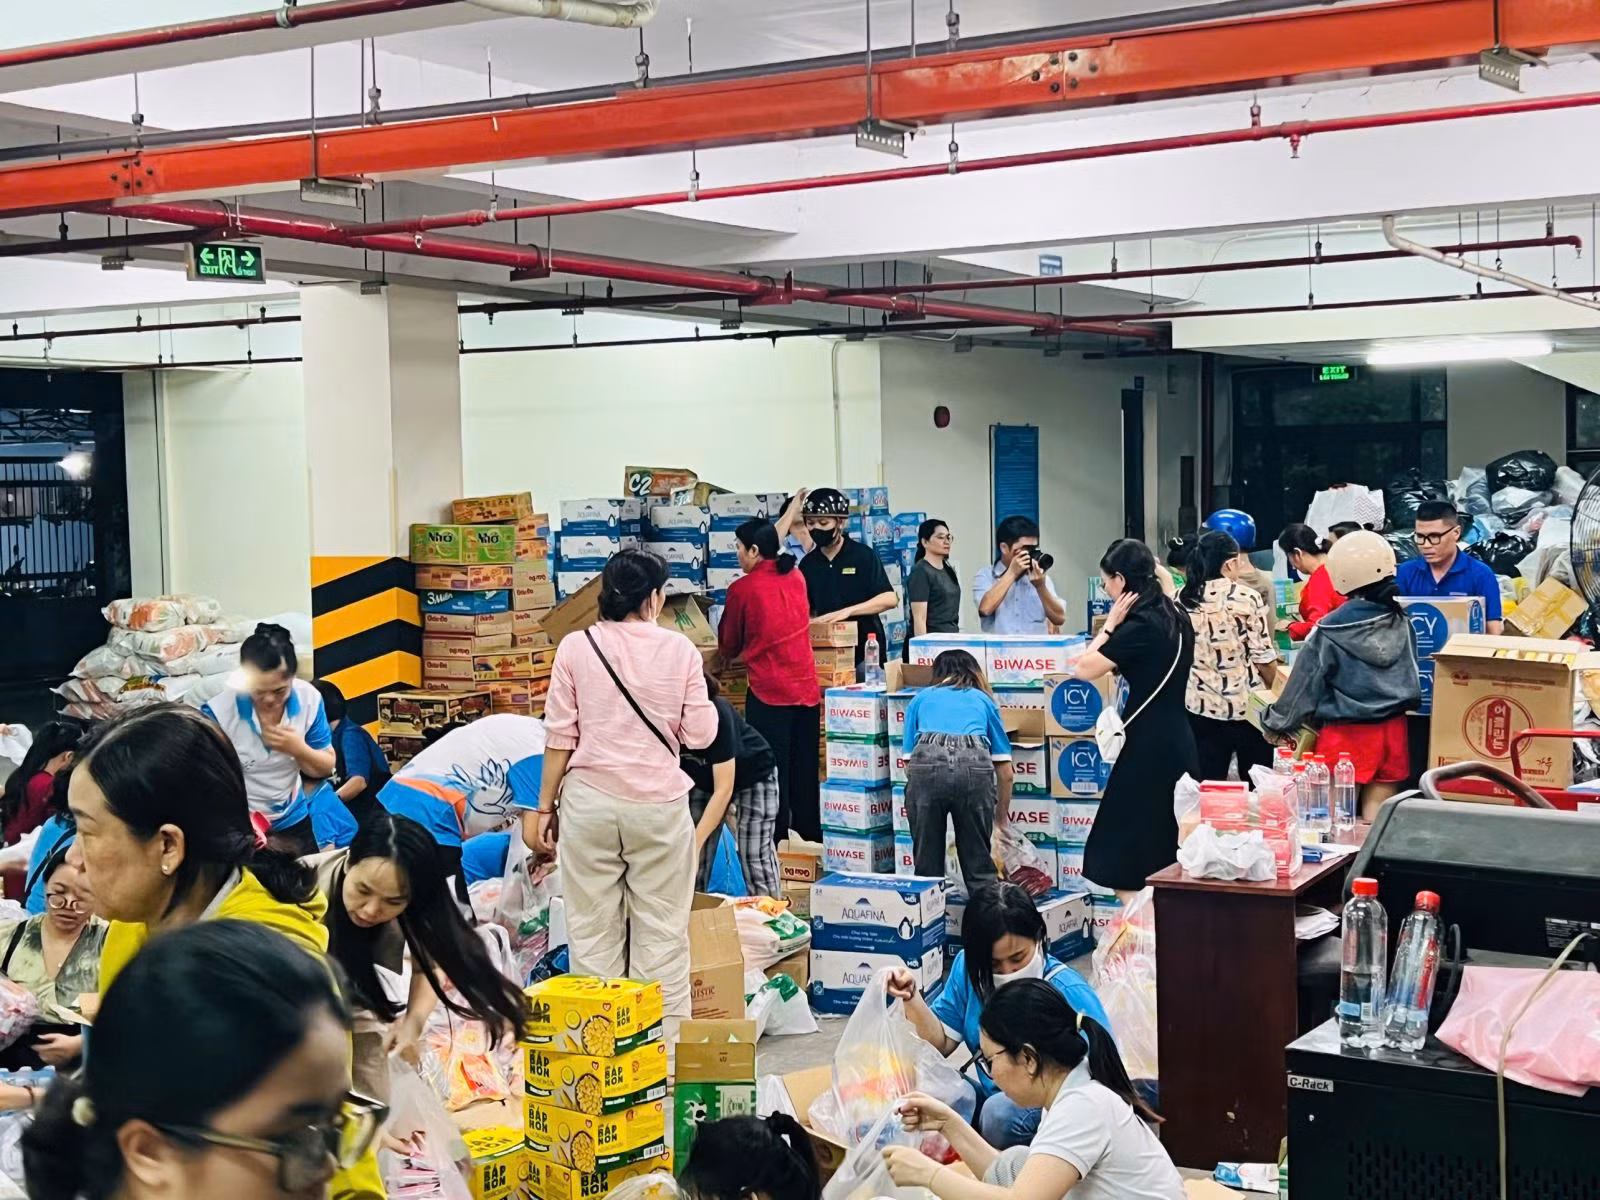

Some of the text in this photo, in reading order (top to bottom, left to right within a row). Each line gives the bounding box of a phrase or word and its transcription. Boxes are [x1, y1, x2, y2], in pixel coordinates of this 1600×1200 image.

[201, 265, 218, 274] EXIT
[1322, 366, 1346, 374] EXIT
[629, 473, 652, 496] C2
[1410, 616, 1438, 636] CY
[994, 659, 1056, 671] BIWASE
[1064, 689, 1090, 705] ICY
[830, 708, 871, 719] BIWASE
[831, 757, 869, 768] BIWASE
[1071, 751, 1097, 768] ICY
[823, 801, 860, 813] BIWASE
[870, 801, 893, 815] BIW
[1062, 816, 1093, 825] BIWA
[827, 848, 865, 860] BIWASE
[874, 846, 895, 862] BIW
[841, 907, 886, 923] AQUAFINA
[842, 971, 872, 986] AQUAF
[529, 1064, 550, 1078] NON
[604, 1075, 624, 1088] NON
[1290, 1077, 1329, 1090] C-Rack
[528, 1119, 548, 1133] NON
[484, 1176, 506, 1192] NON
[581, 1183, 609, 1198] NON
